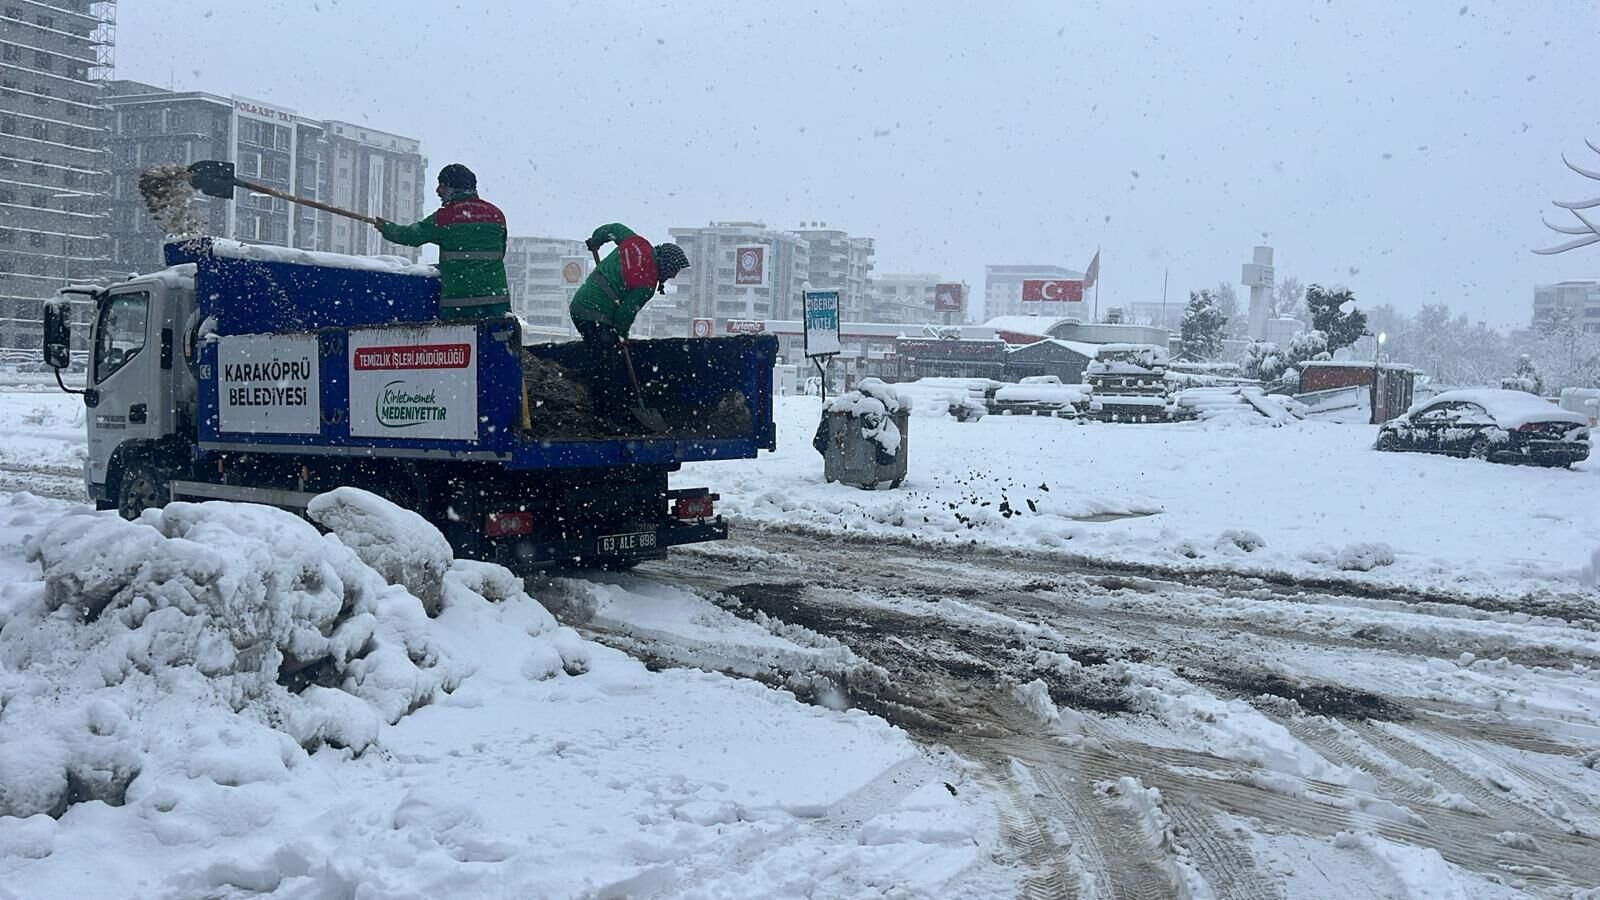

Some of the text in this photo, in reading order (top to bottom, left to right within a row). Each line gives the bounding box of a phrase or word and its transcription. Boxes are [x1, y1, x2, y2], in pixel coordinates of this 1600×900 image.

[359, 348, 465, 368] TEMİZLİK İŞLERİ MÜDÜRLÜĞÜ
[224, 356, 310, 382] KARAKÖPRÜ
[229, 387, 307, 406] BELEDİYESİ
[383, 388, 436, 404] Kirletmemek
[381, 406, 447, 421] MEDENİYETTİR
[603, 533, 655, 551] 63 ALE 898
